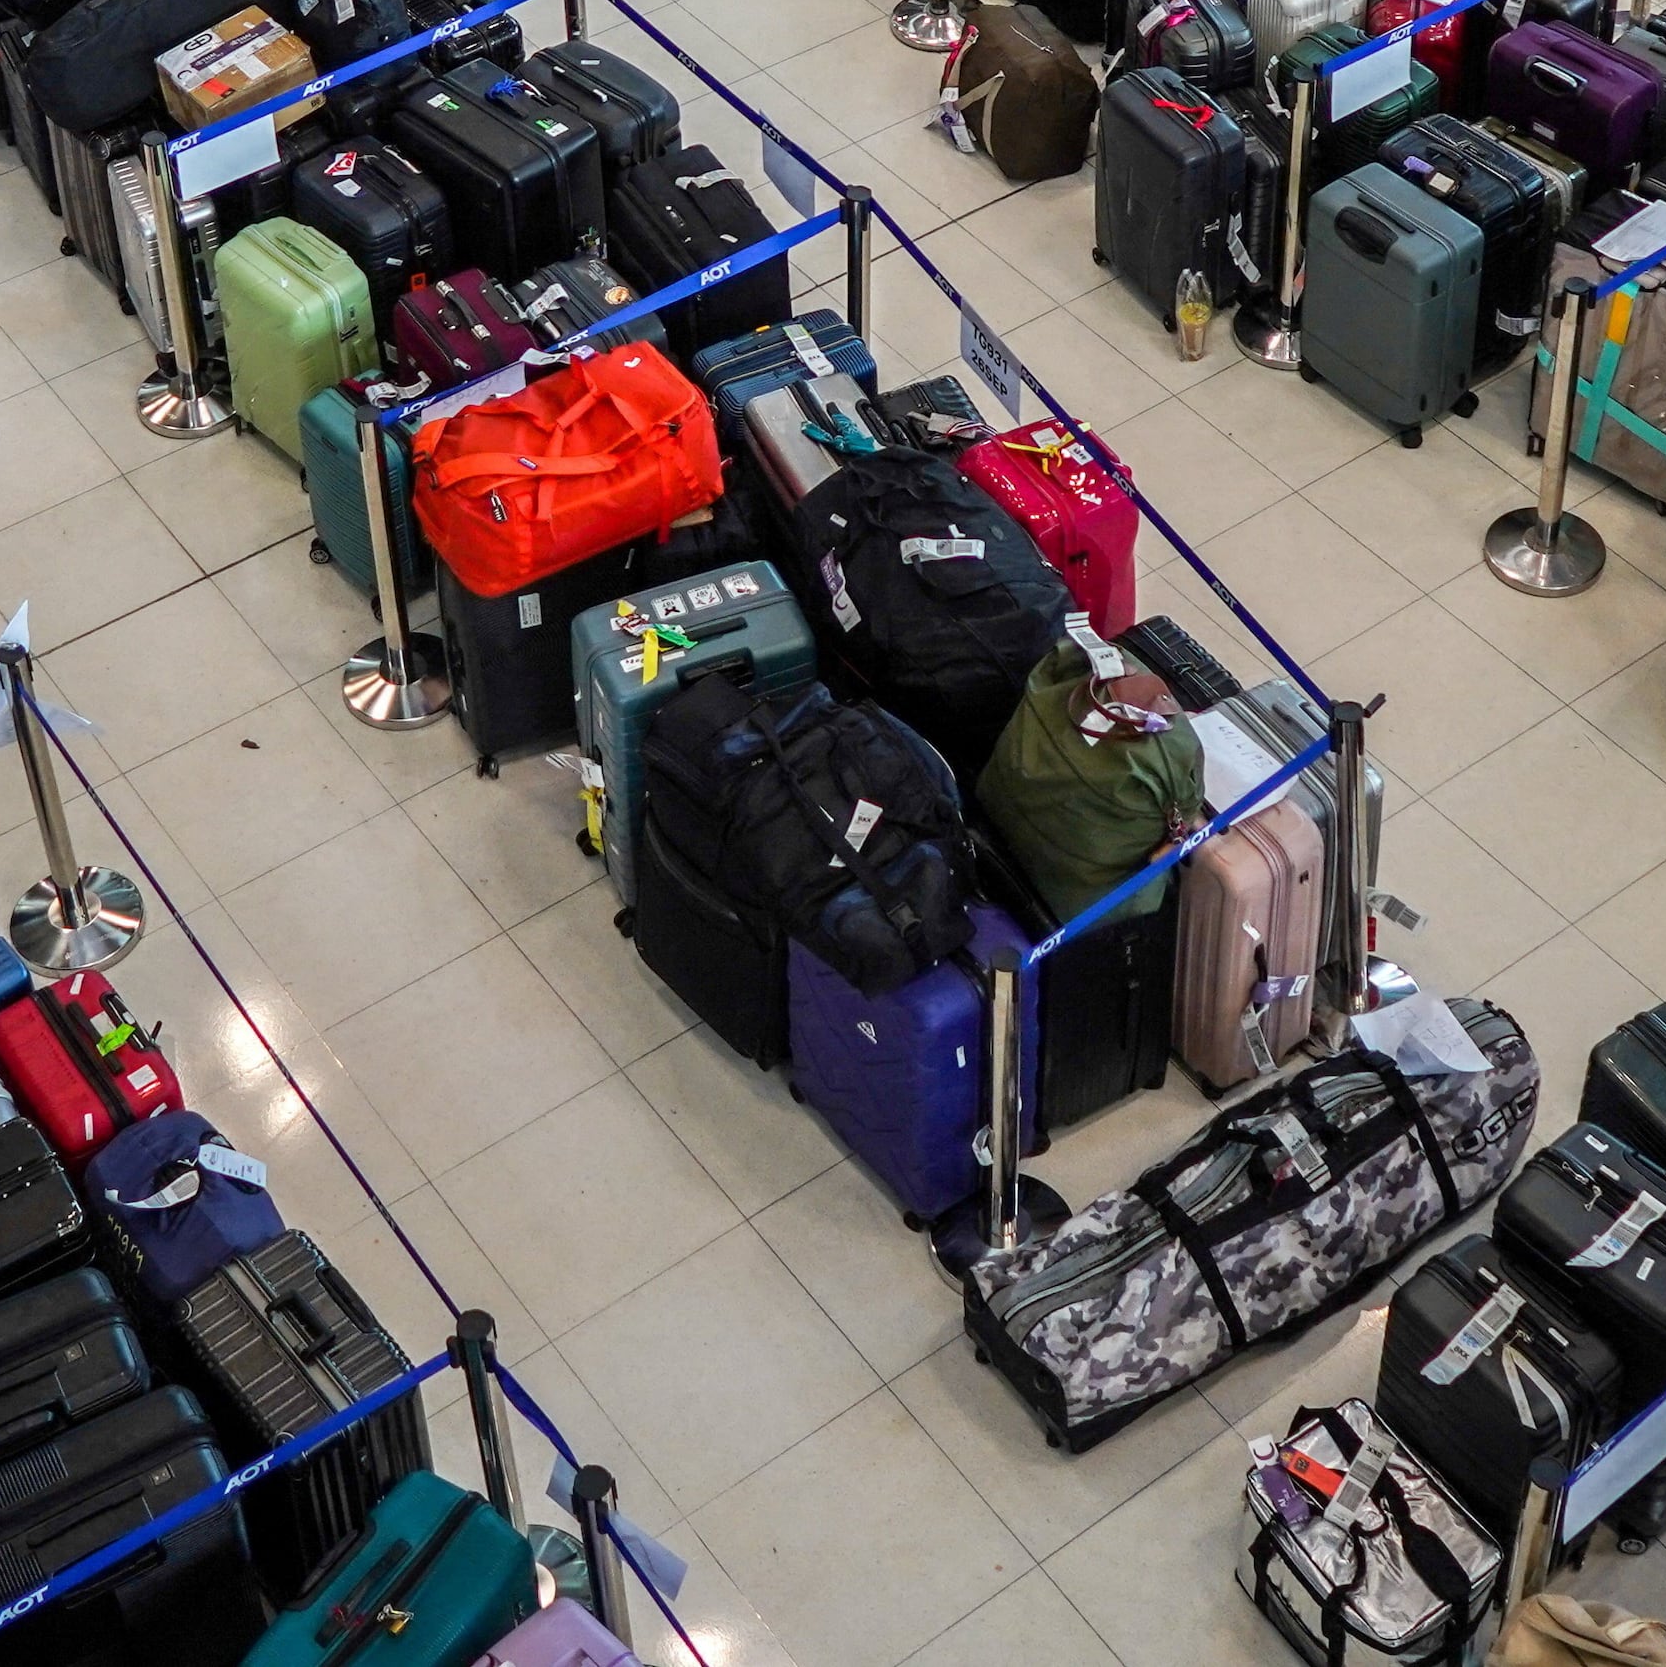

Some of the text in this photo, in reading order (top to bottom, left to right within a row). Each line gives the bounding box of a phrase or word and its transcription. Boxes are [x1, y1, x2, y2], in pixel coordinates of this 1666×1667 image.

[432, 18, 461, 39] AOT
[1388, 25, 1412, 43] AOT
[303, 77, 332, 96] AOT
[762, 123, 781, 142] AOT
[701, 261, 730, 285] AOT
[970, 323, 1010, 374] TG931
[971, 351, 1008, 398] 26SEP
[858, 815, 871, 823] BKK
[1180, 823, 1217, 855] AOT
[1029, 930, 1064, 963] AOT
[1451, 1087, 1536, 1158] OGIO
[1453, 1345, 1470, 1360] BKK
[224, 1454, 274, 1493] AOT
